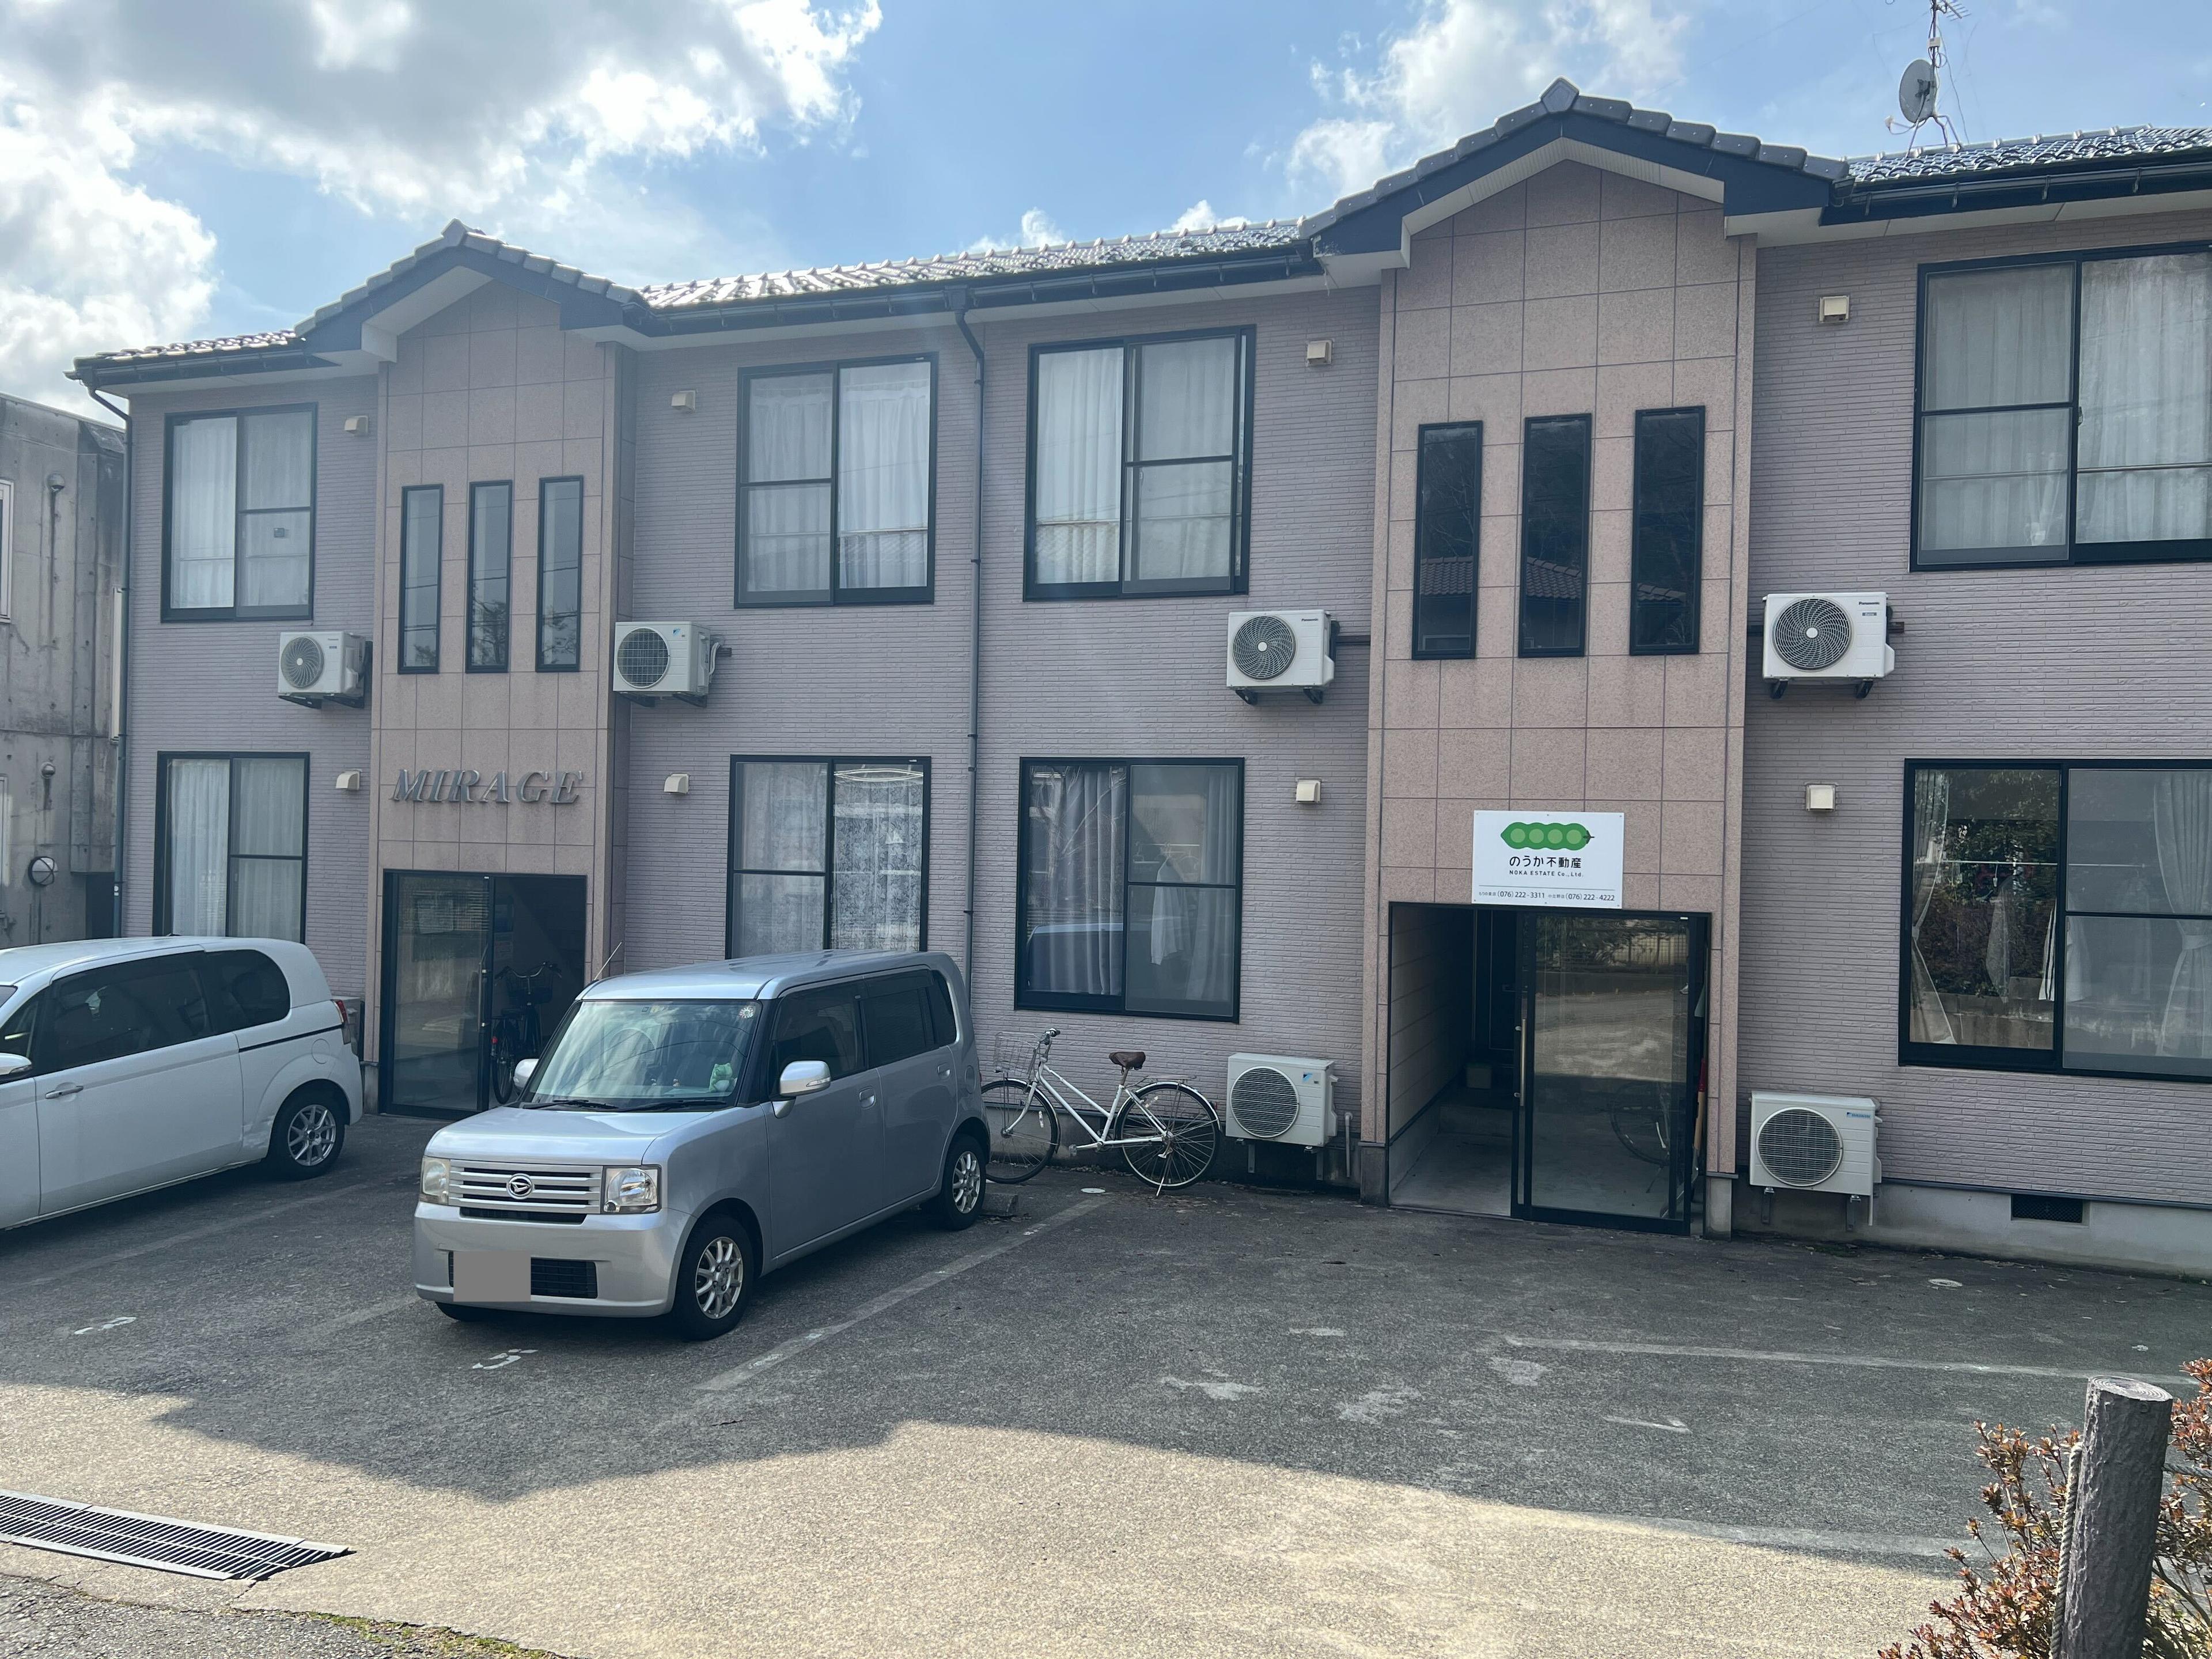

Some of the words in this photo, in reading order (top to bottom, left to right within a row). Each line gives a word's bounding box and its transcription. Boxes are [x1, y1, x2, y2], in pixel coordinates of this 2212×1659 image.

[389, 770, 583, 804] MIRAGE
[1509, 855, 1581, 868] のうか不動産
